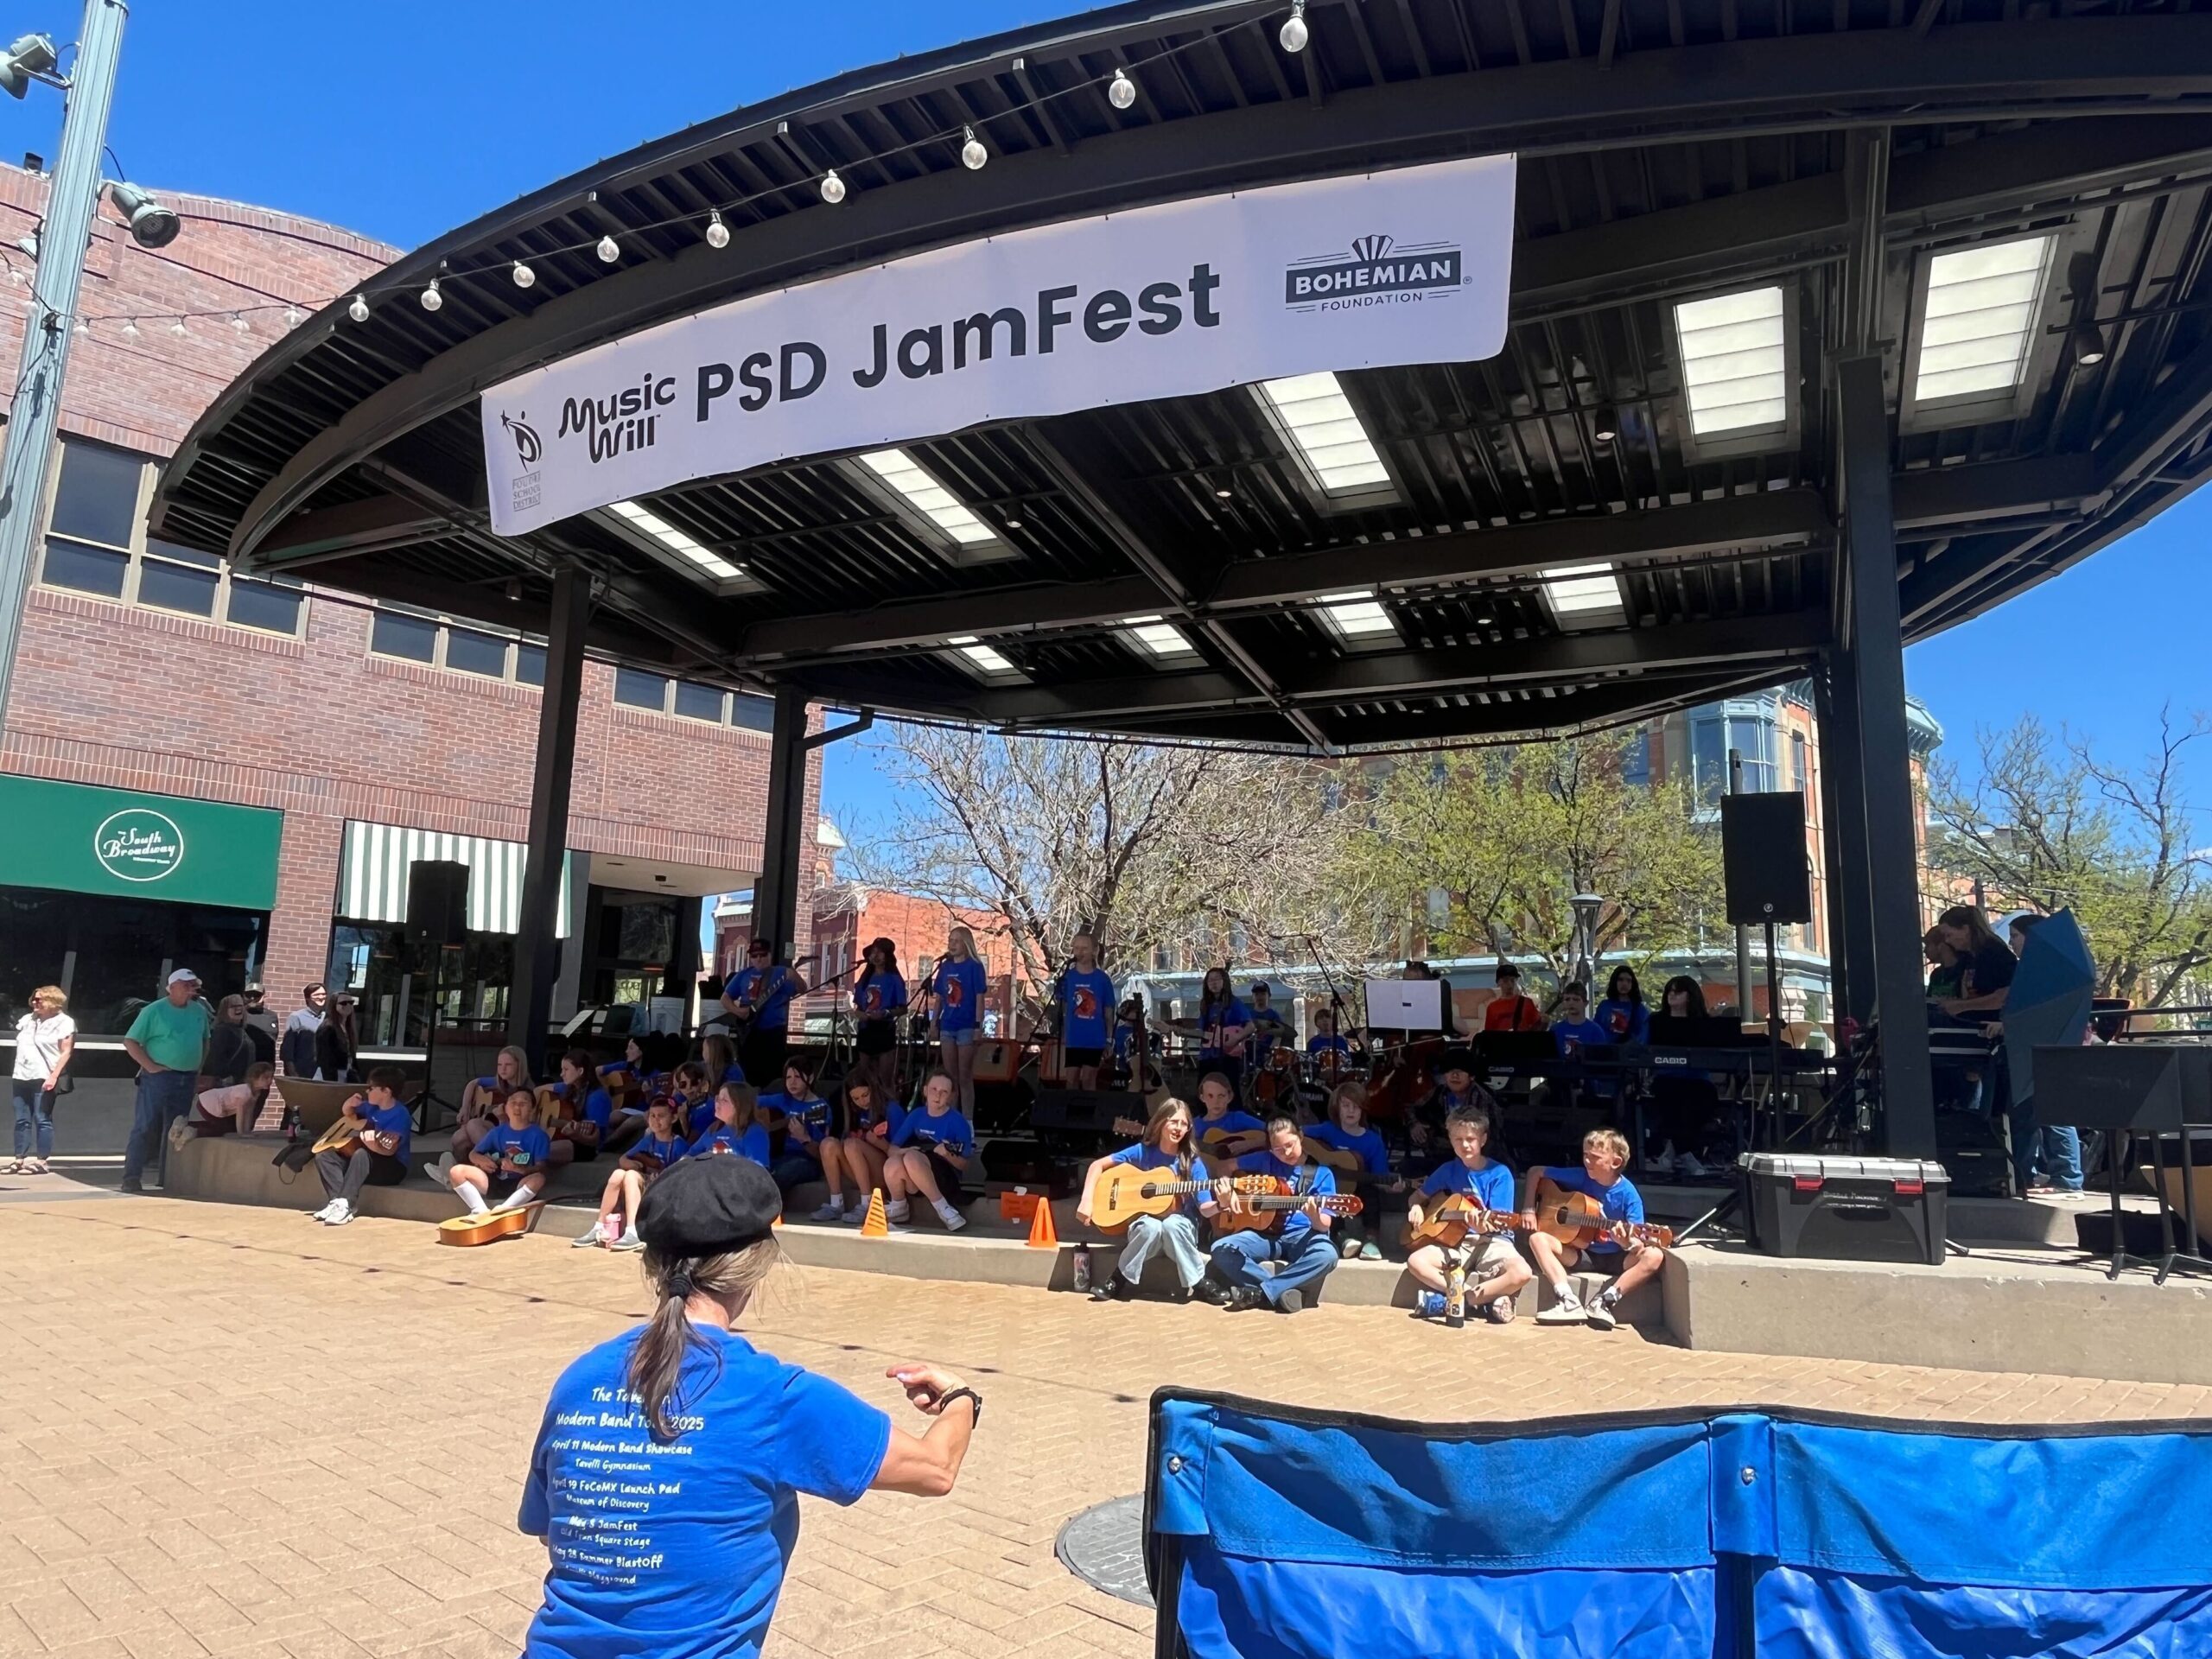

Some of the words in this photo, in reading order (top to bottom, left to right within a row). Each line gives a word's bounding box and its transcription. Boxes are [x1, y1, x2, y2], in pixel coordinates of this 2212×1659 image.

[1296, 260, 1451, 295] BOHEMIAN
[1321, 292, 1422, 311] FOUNDATION
[696, 341, 827, 423] PSD
[852, 264, 1221, 389] JamFest
[558, 372, 676, 438] Music
[588, 415, 655, 464] Will
[512, 484, 541, 500] SCHOOL
[118, 828, 162, 846] South
[103, 839, 176, 858] Broadway
[592, 1387, 612, 1402] The
[556, 1410, 595, 1427] Modern
[600, 1412, 634, 1428] Band
[671, 1415, 704, 1431] 2025
[552, 1439, 570, 1452] April
[581, 1440, 615, 1452] Modern
[619, 1442, 643, 1453] Band
[645, 1442, 693, 1455] Showcase
[602, 1460, 652, 1474] Gymnasium
[580, 1480, 617, 1492] FoCoMX
[620, 1482, 655, 1495] Launch
[658, 1482, 680, 1494] Pad
[598, 1497, 608, 1509] of
[610, 1498, 649, 1512] Discovery
[598, 1520, 638, 1531] JamFest
[595, 1534, 621, 1547] Square
